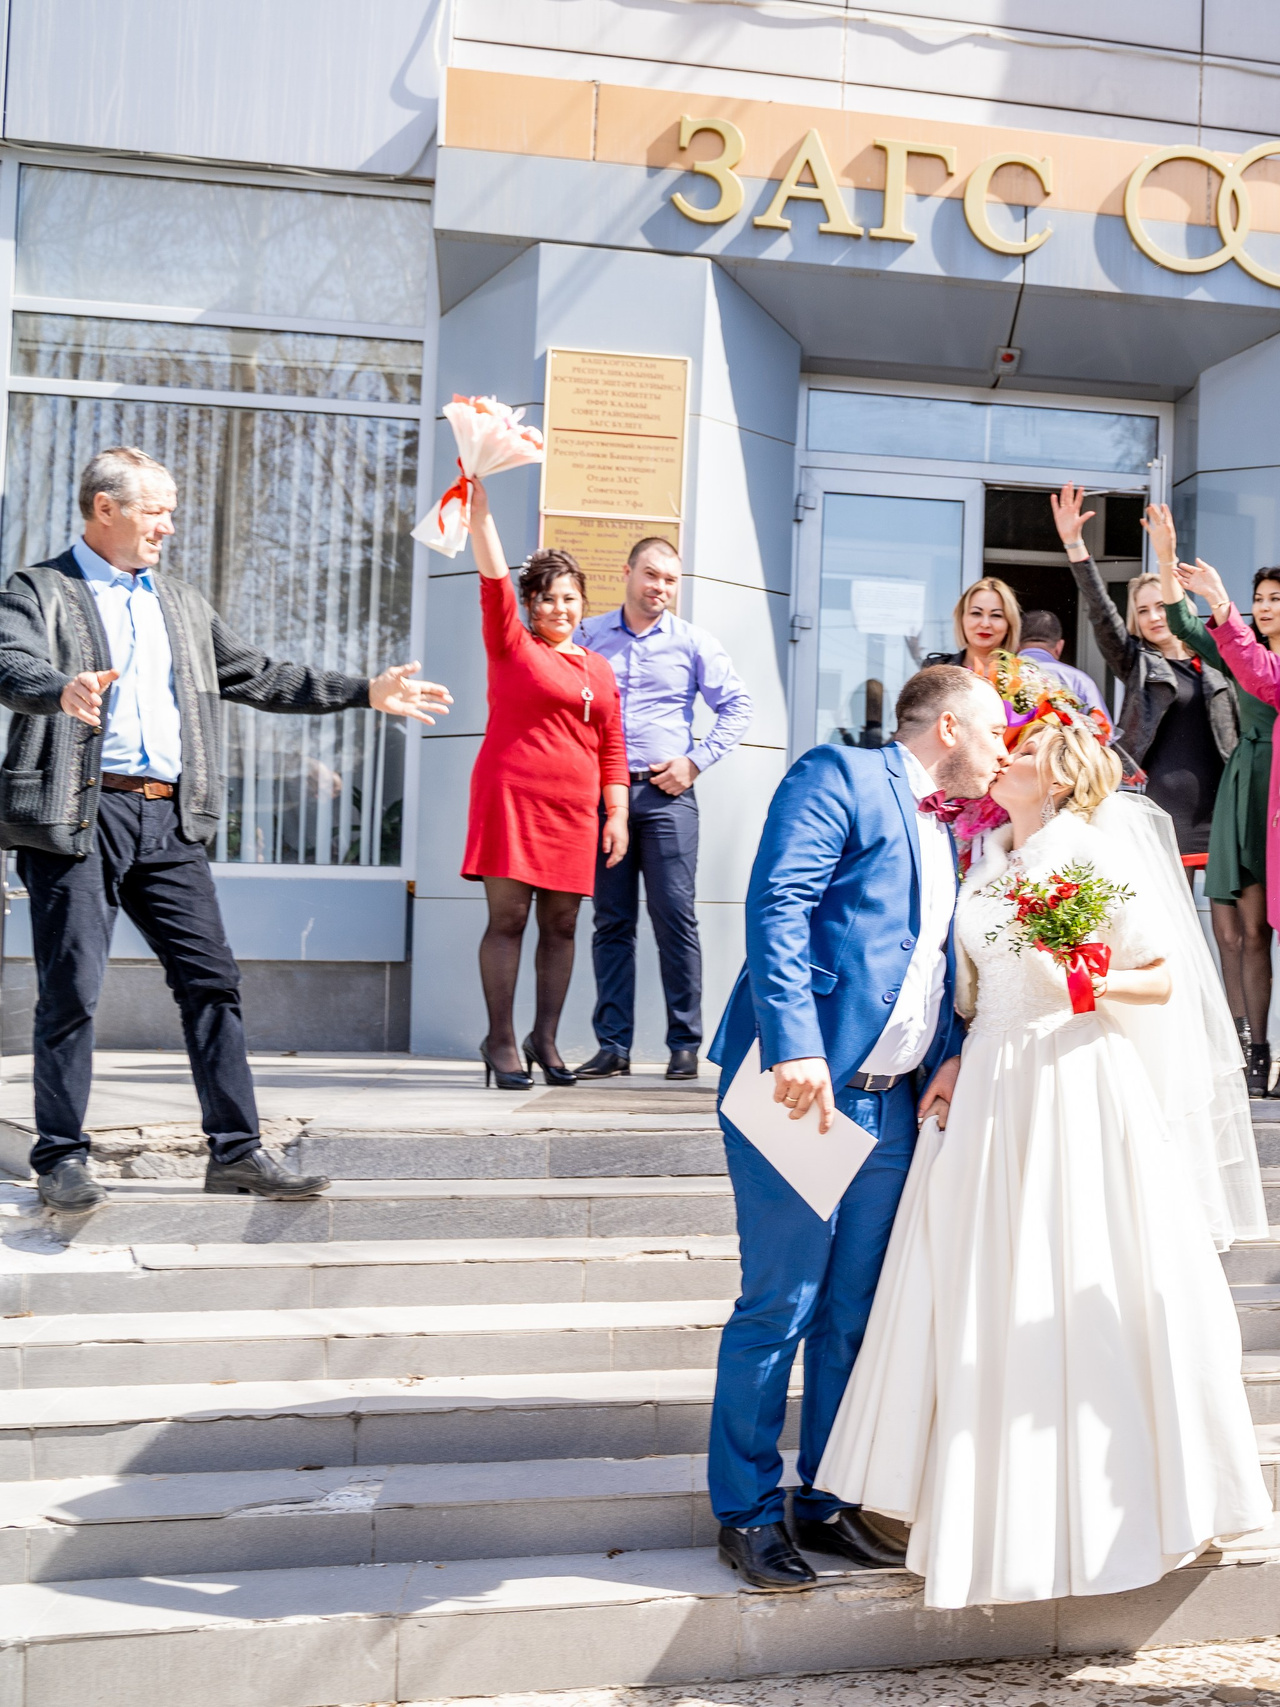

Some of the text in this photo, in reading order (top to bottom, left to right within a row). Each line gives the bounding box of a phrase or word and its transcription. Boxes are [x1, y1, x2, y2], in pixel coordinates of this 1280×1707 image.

[671, 114, 1053, 255] ЗАГС
[555, 436, 635, 449] Государственный
[553, 448, 676, 464] Республики Башкортостан
[586, 464, 613, 472] делам
[586, 473, 641, 484] Отдел ЗАГС
[587, 485, 639, 496] Советского
[581, 498, 614, 506] района
